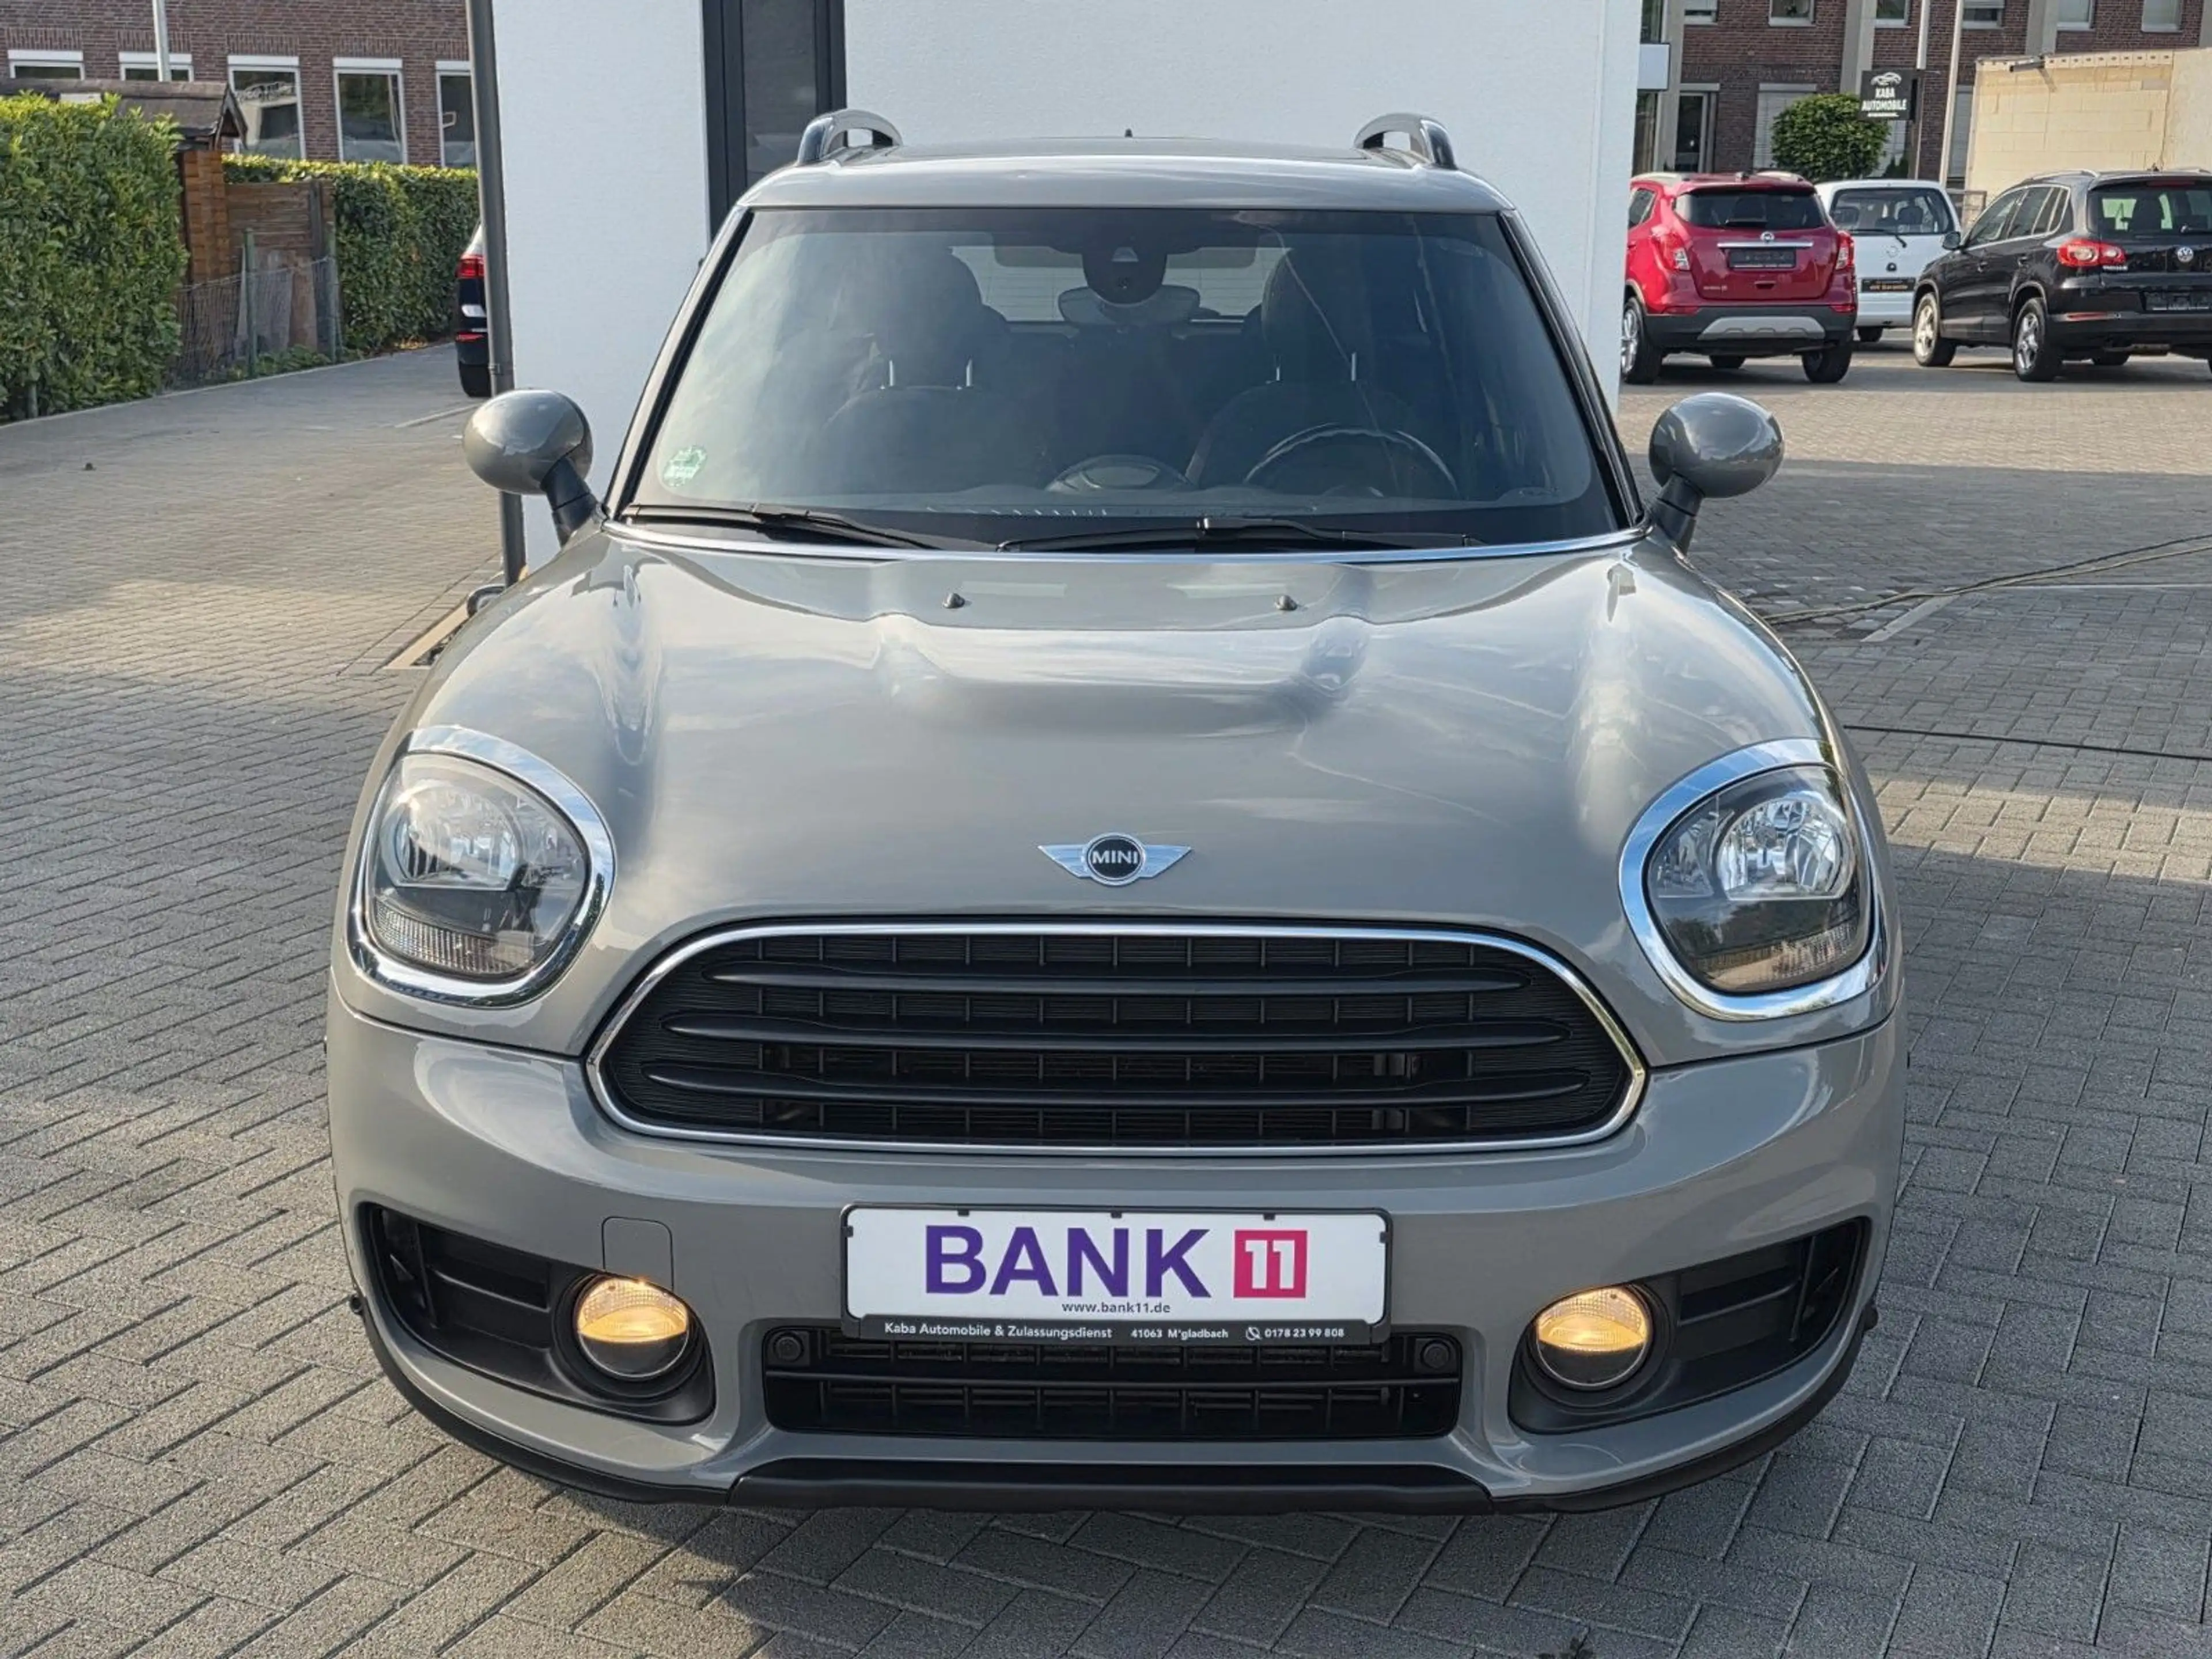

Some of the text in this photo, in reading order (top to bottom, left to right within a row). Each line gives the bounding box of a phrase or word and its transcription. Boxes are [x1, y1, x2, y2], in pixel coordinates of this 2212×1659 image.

[1092, 850, 1139, 864] MINI
[926, 1225, 1295, 1297] BANK 11
[1062, 1301, 1171, 1315] www.bank11.de
[884, 1323, 915, 1334] Kaba
[920, 1324, 991, 1337] Automobile
[995, 1326, 1004, 1336] &
[1007, 1325, 1113, 1340] Zulassungsdienst
[1130, 1329, 1162, 1338] 41063
[1168, 1329, 1229, 1340] M'gladbach
[1264, 1329, 1291, 1338] 0178
[1293, 1328, 1306, 1338] 23
[1308, 1328, 1322, 1337] 99
